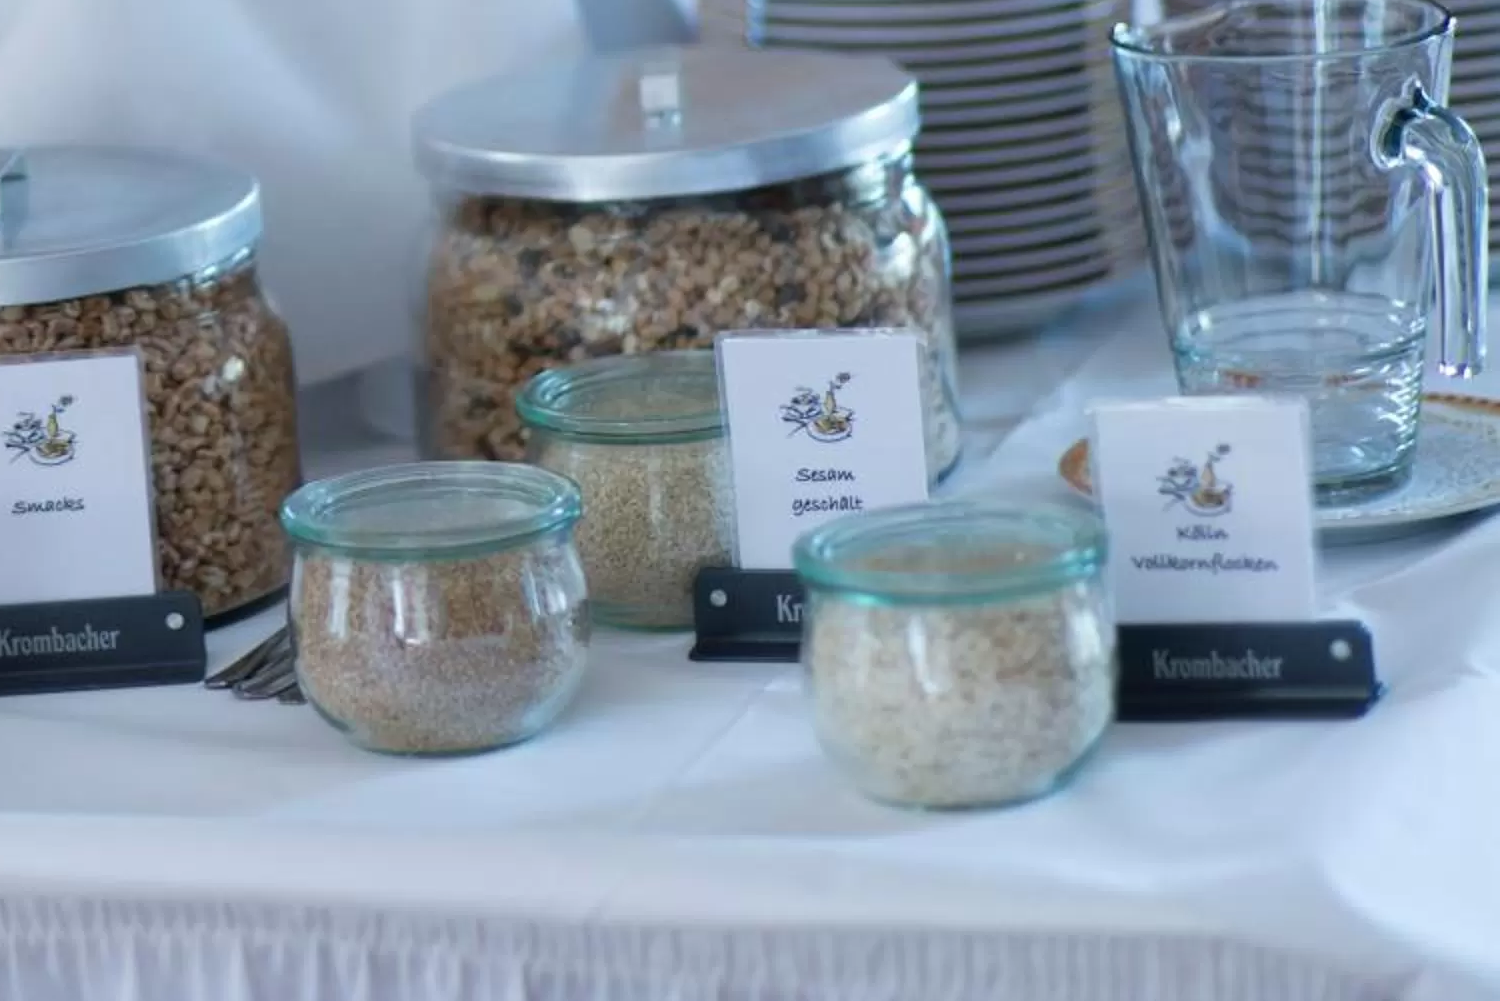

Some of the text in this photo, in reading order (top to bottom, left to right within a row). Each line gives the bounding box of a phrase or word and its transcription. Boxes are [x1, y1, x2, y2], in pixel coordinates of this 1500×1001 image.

[796, 467, 856, 483] Sesam
[11, 496, 85, 515] Smacks
[1152, 649, 1283, 680] Krombacher
